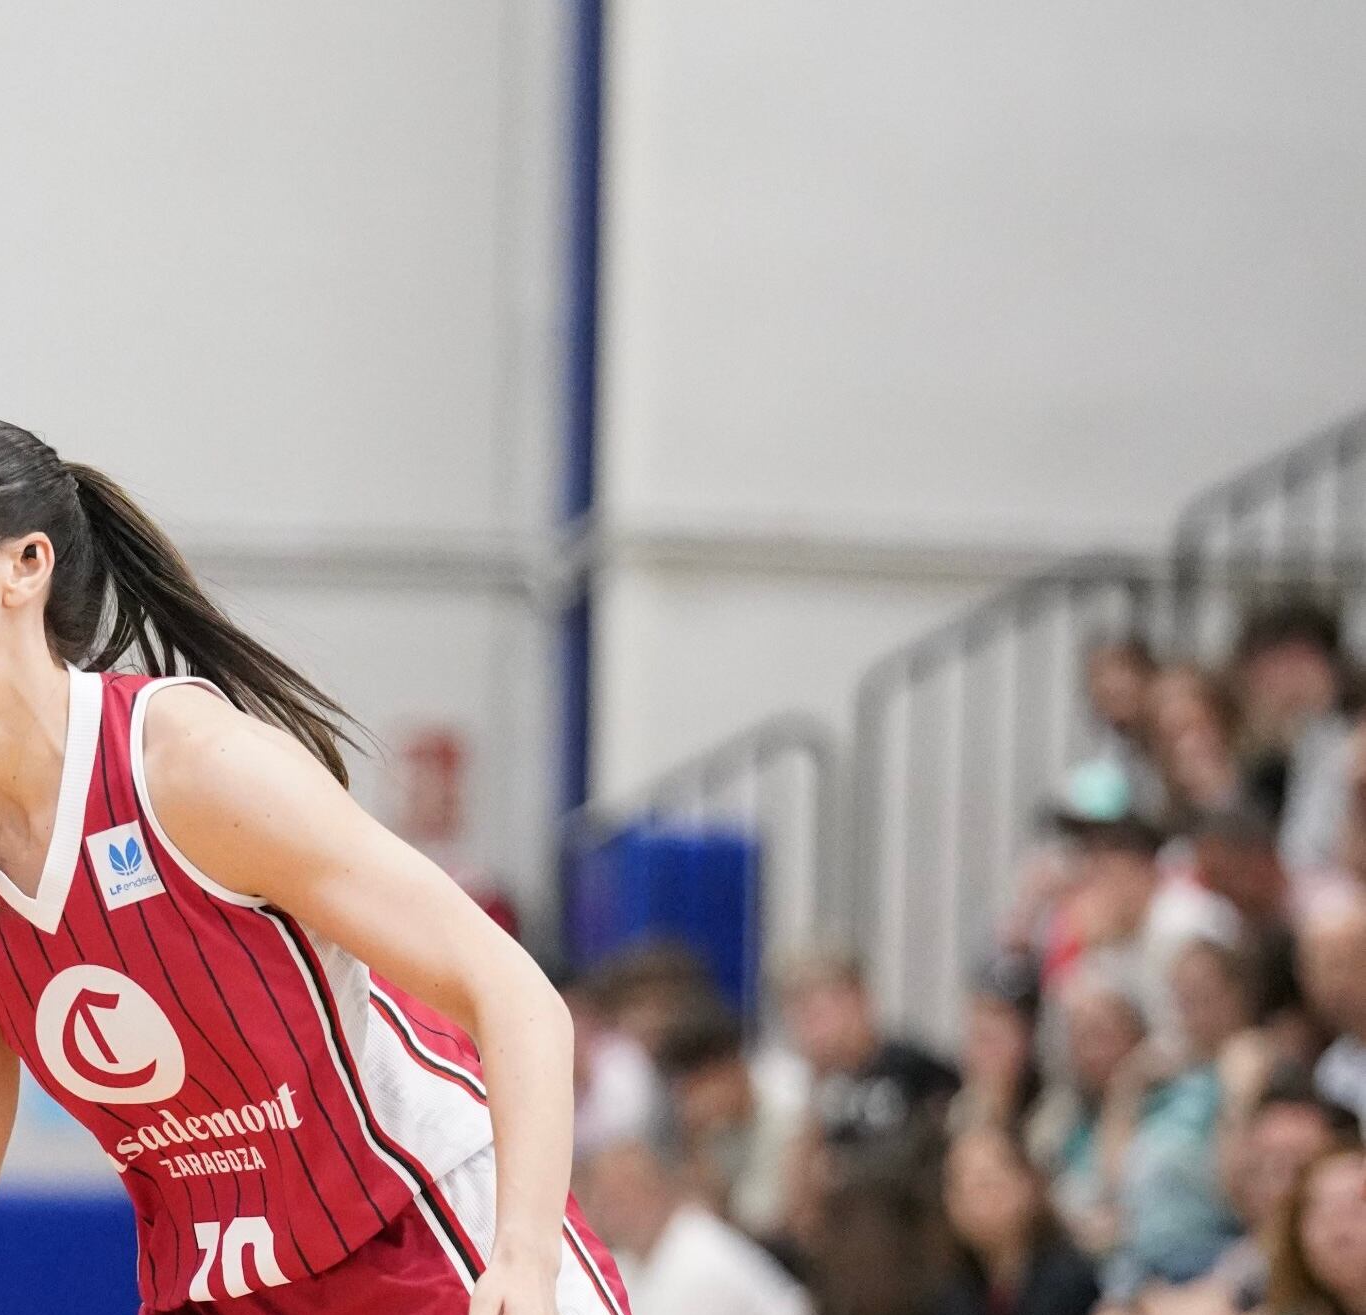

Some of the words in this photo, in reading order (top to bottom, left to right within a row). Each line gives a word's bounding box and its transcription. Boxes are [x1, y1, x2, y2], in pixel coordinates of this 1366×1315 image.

[109, 884, 122, 895] LF
[123, 873, 158, 891] endesa
[159, 1146, 267, 1179] ZARAGOZA
